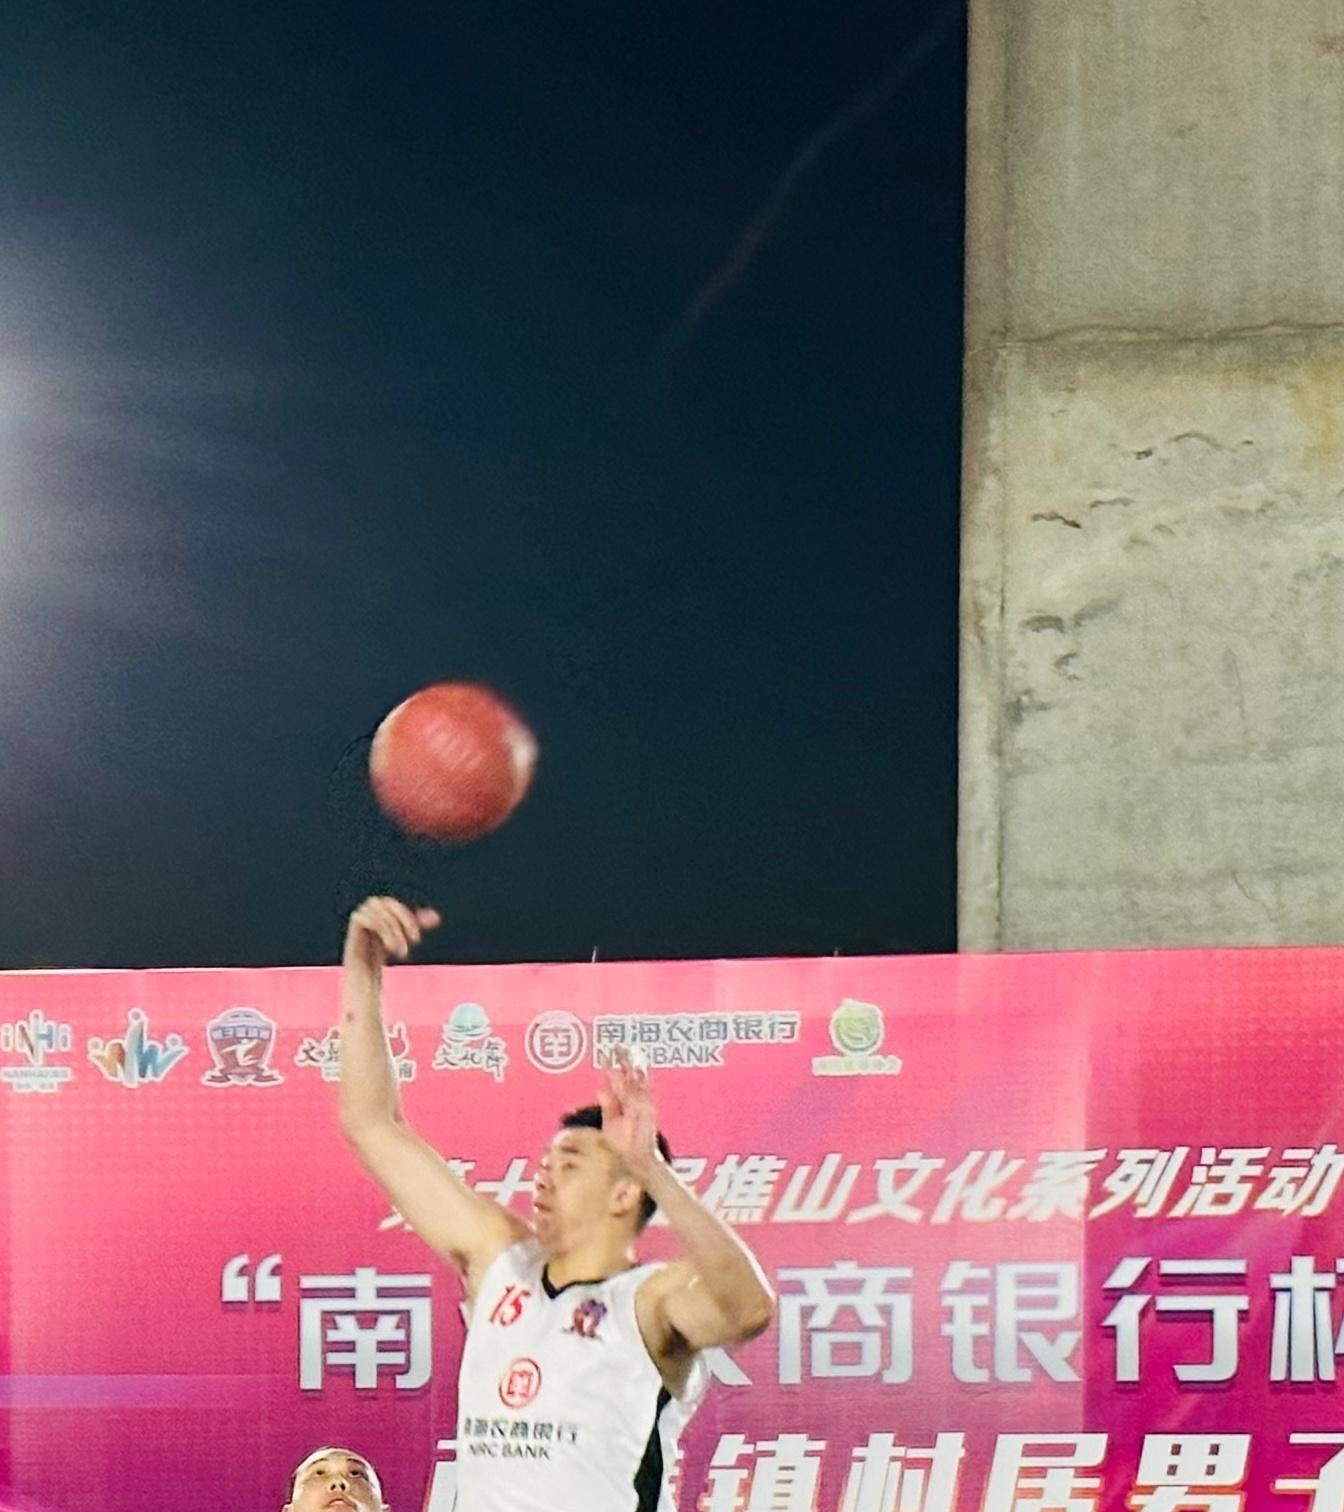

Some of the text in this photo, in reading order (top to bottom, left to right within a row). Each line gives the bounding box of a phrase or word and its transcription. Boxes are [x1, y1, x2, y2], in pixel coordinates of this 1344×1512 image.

[595, 1013, 797, 1044] 南海农商银行
[489, 1285, 532, 1327] 15
